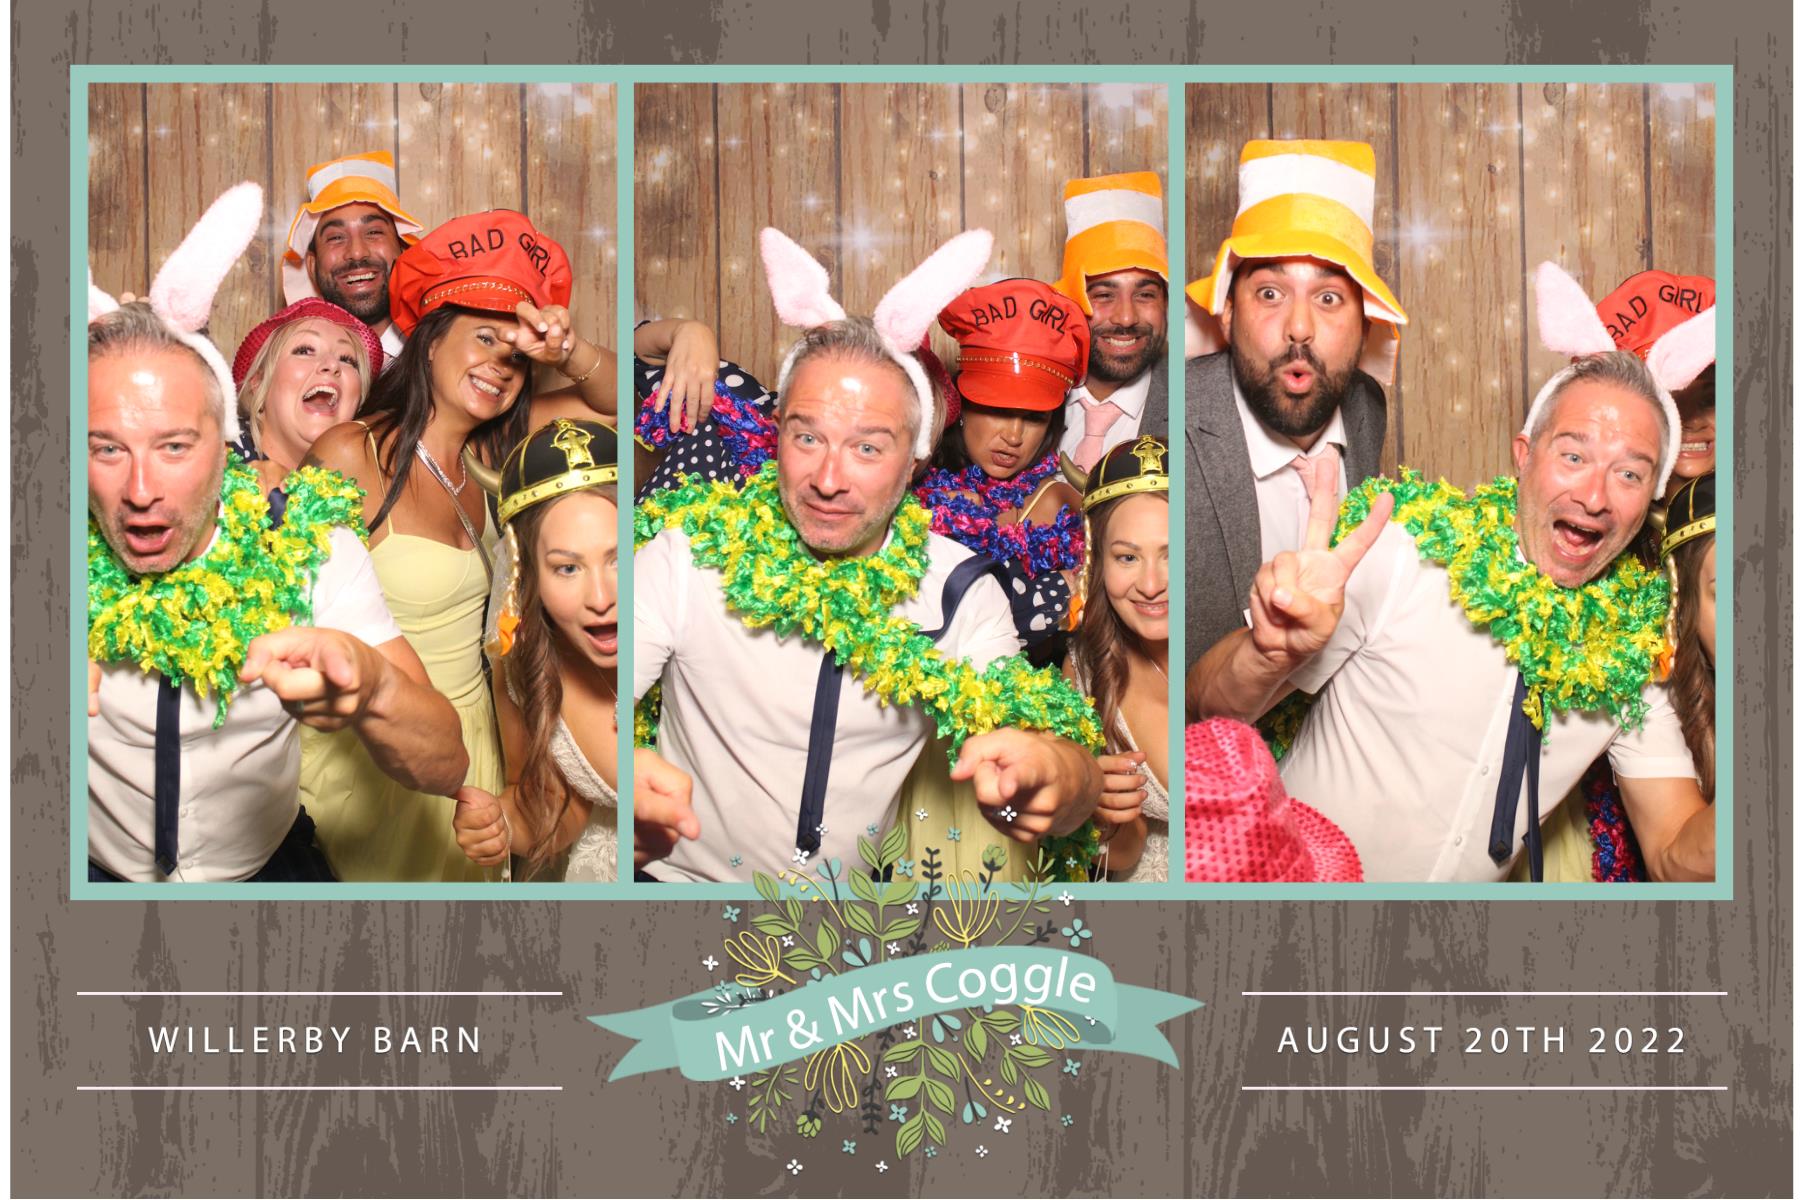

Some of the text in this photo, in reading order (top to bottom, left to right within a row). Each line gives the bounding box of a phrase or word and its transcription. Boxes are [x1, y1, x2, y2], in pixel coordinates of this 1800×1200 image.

[448, 228, 551, 279] BAD GIRL
[971, 296, 1070, 335] BAD GIRL
[1658, 284, 1703, 314] GIRL
